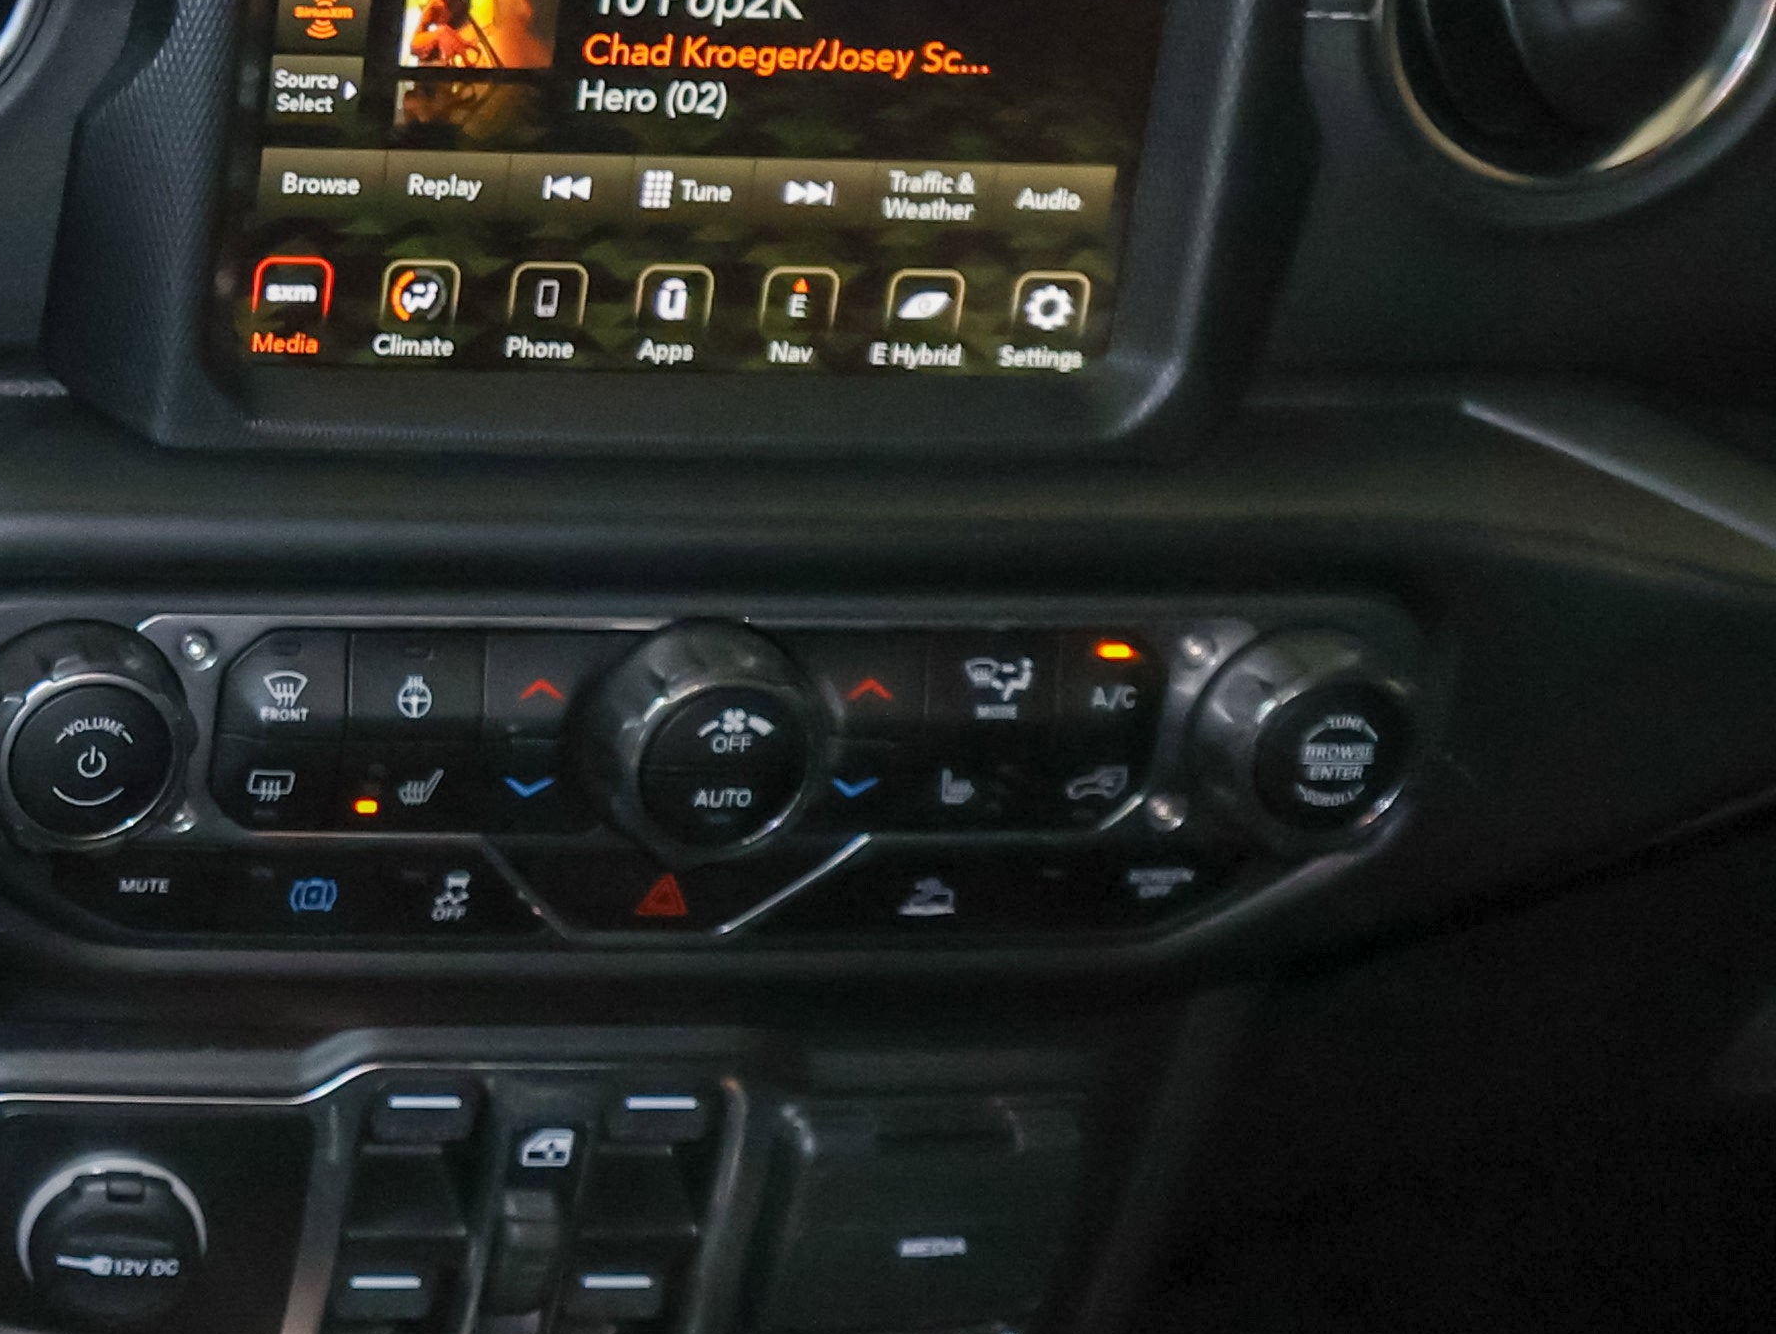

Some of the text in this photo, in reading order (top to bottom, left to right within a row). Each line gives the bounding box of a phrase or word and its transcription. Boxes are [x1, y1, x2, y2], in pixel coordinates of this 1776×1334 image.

[582, 32, 992, 79] Chad Kroeger/Josey Sc...
[274, 68, 339, 90] Source
[276, 92, 334, 113] Select
[576, 79, 728, 120] Hero (02)
[282, 172, 360, 196] Browse
[407, 175, 482, 201] Replay
[680, 180, 733, 203] Tune
[888, 171, 975, 195] Traffic &
[883, 198, 975, 221] Weather
[1016, 188, 1082, 212] Audio
[788, 294, 808, 319] E
[251, 333, 319, 354] Media
[373, 334, 454, 358] Climate
[505, 336, 574, 360] Phone
[637, 339, 694, 363] Apps
[768, 342, 813, 364] Nav
[998, 346, 1084, 372] Settings
[1091, 685, 1136, 709] A/C
[260, 707, 309, 722] FRONT
[64, 717, 124, 737] VOLUME
[712, 735, 752, 753] OFF
[693, 788, 752, 808] AUTO
[118, 877, 170, 894] MUTE
[431, 905, 466, 921] OFF
[113, 1259, 180, 1276] 12V DC
